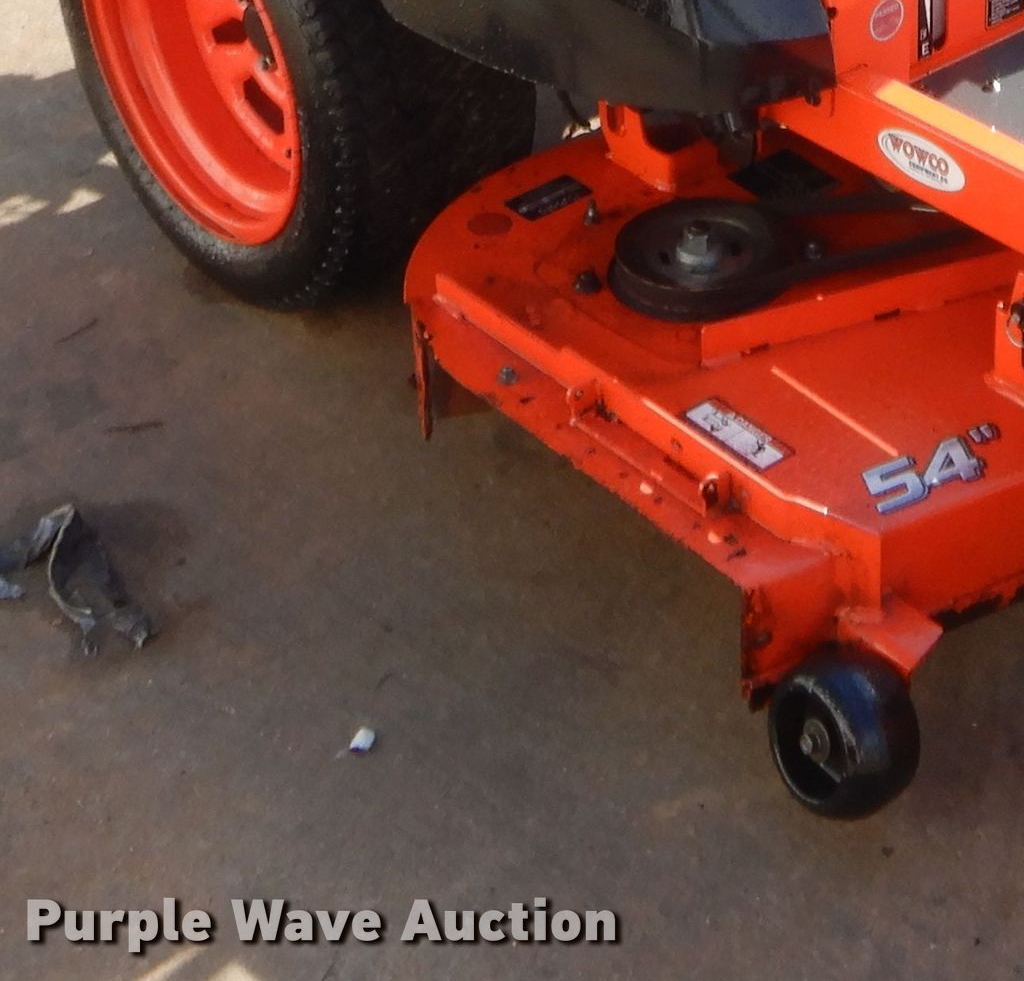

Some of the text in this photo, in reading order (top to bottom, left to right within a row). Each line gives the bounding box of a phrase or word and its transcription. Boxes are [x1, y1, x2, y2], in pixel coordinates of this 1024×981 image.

[921, 42, 930, 56] E
[887, 132, 949, 177] WOWCO
[862, 423, 1000, 515] 54"
